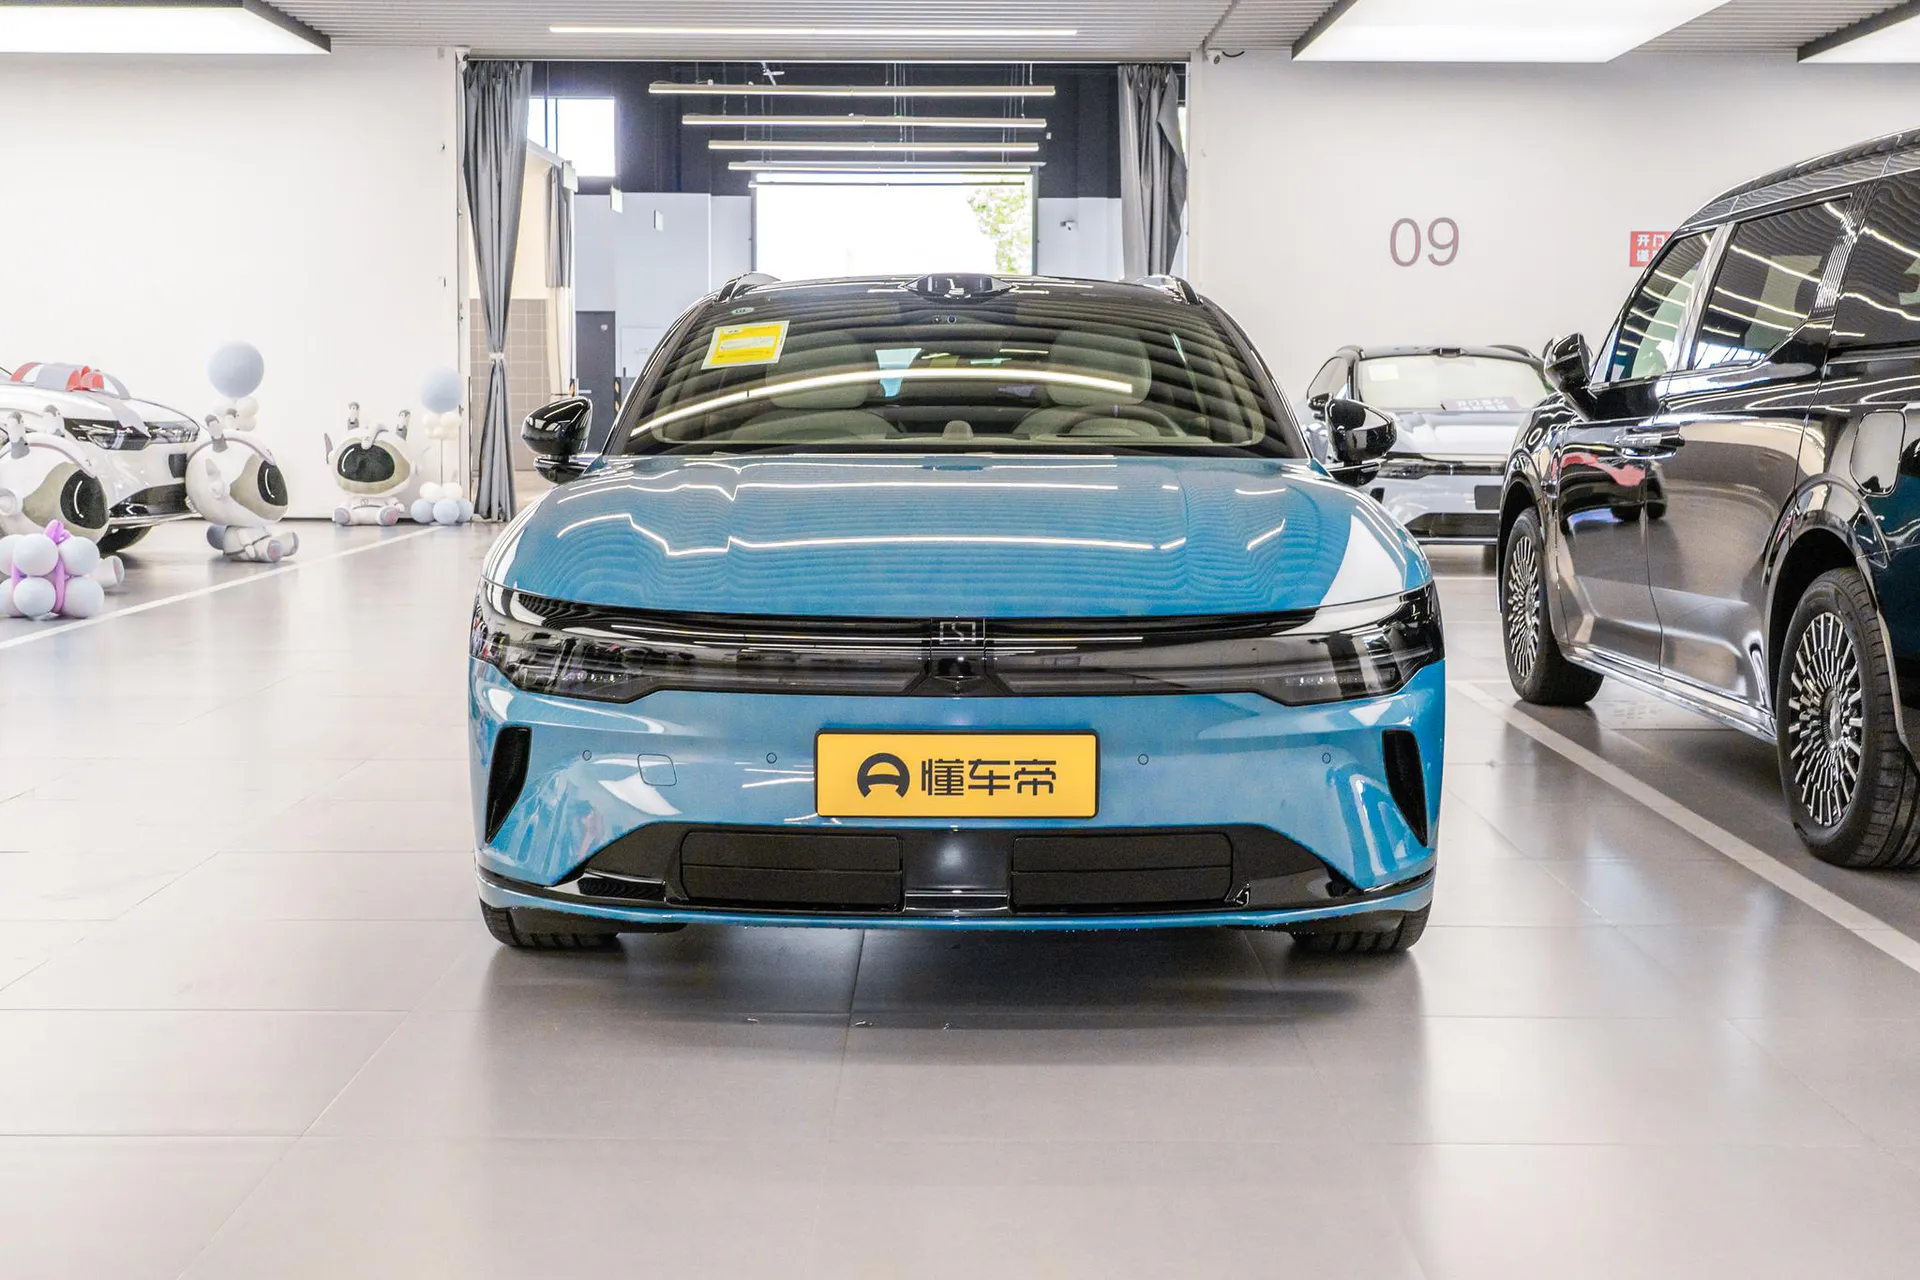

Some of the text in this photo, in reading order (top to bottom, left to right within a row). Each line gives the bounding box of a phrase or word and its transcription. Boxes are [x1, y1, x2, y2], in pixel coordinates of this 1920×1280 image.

[1390, 217, 1459, 267] 09
[921, 758, 1057, 796] 懂车帝
